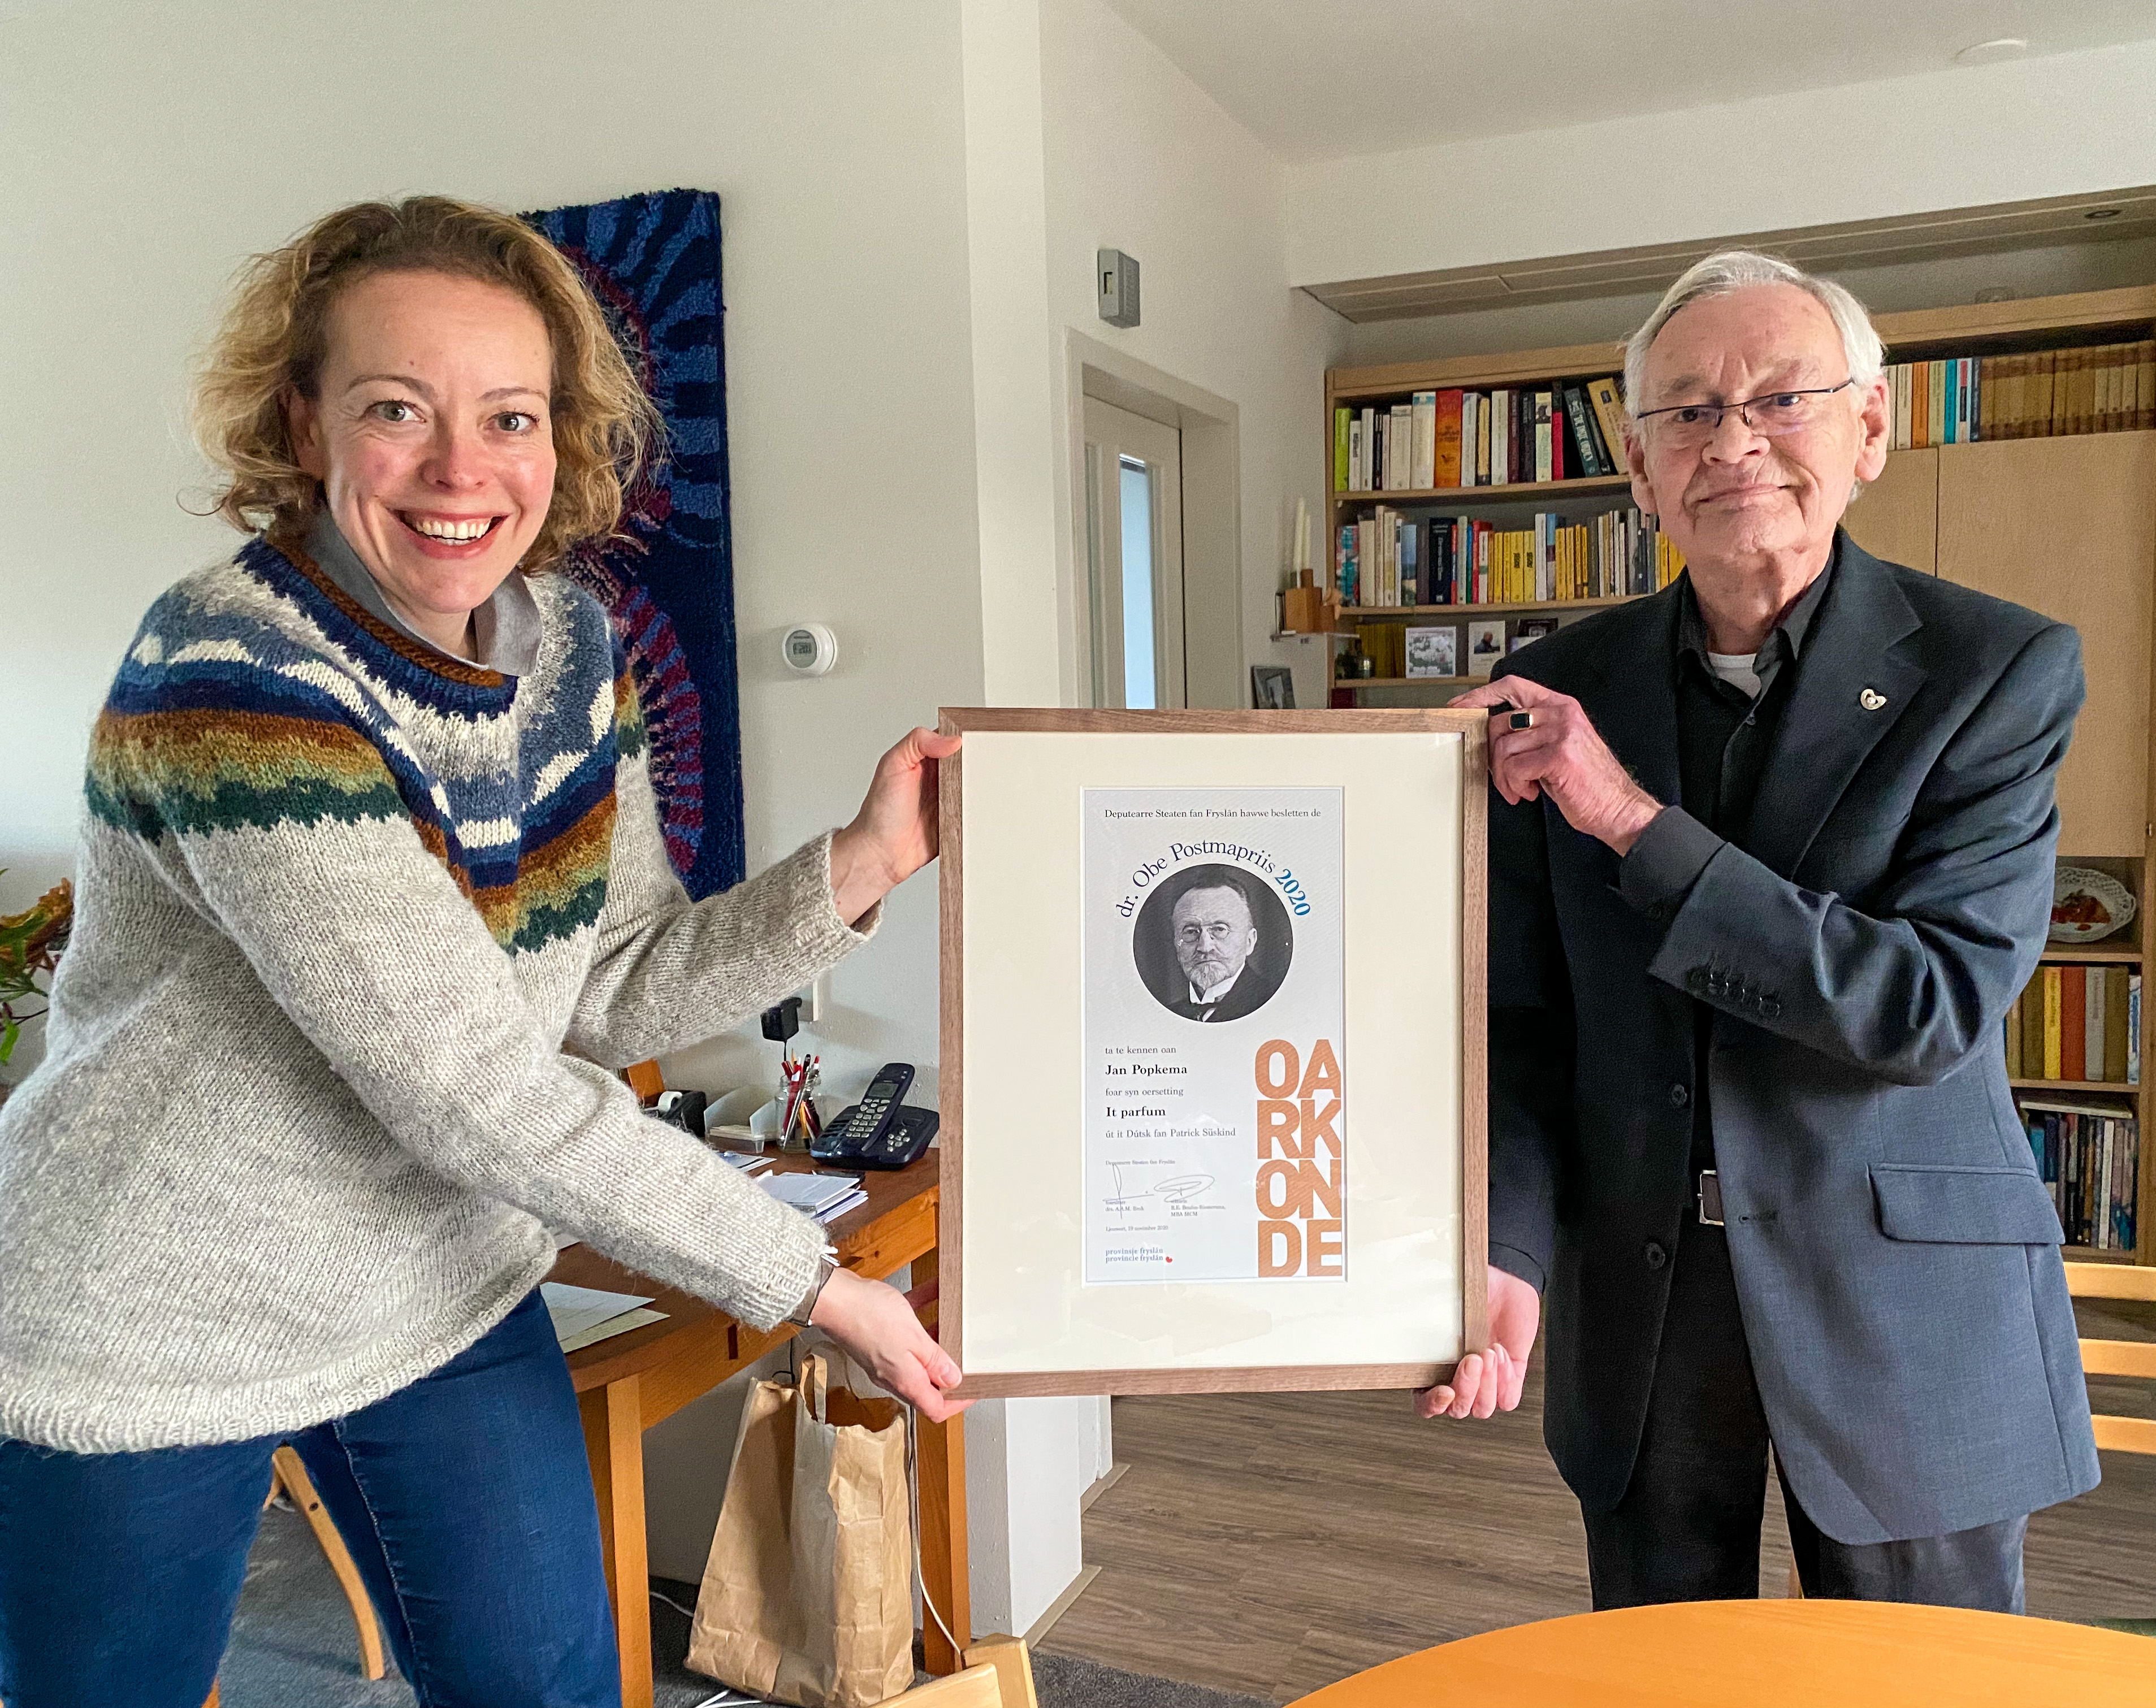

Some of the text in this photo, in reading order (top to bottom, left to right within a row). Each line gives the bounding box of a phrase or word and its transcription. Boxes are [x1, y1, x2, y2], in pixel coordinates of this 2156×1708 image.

[1105, 808, 1321, 820] Deputearre Steaten fan Fryslân hawwe besletten de
[1115, 839, 1311, 918] dr. Obe Postmapriis 2020
[1127, 1046, 1158, 1054] kennen
[1105, 1064, 1188, 1076] Jan Popkema
[1105, 1088, 1123, 1096] foar
[1142, 1087, 1184, 1097] oersetting
[1106, 1106, 1166, 1119] It parfum
[1105, 1127, 1236, 1138] út it Dútsk fan Patrick Süskind
[1105, 1247, 1138, 1256] provinsje
[1105, 1255, 1139, 1264] provincie
